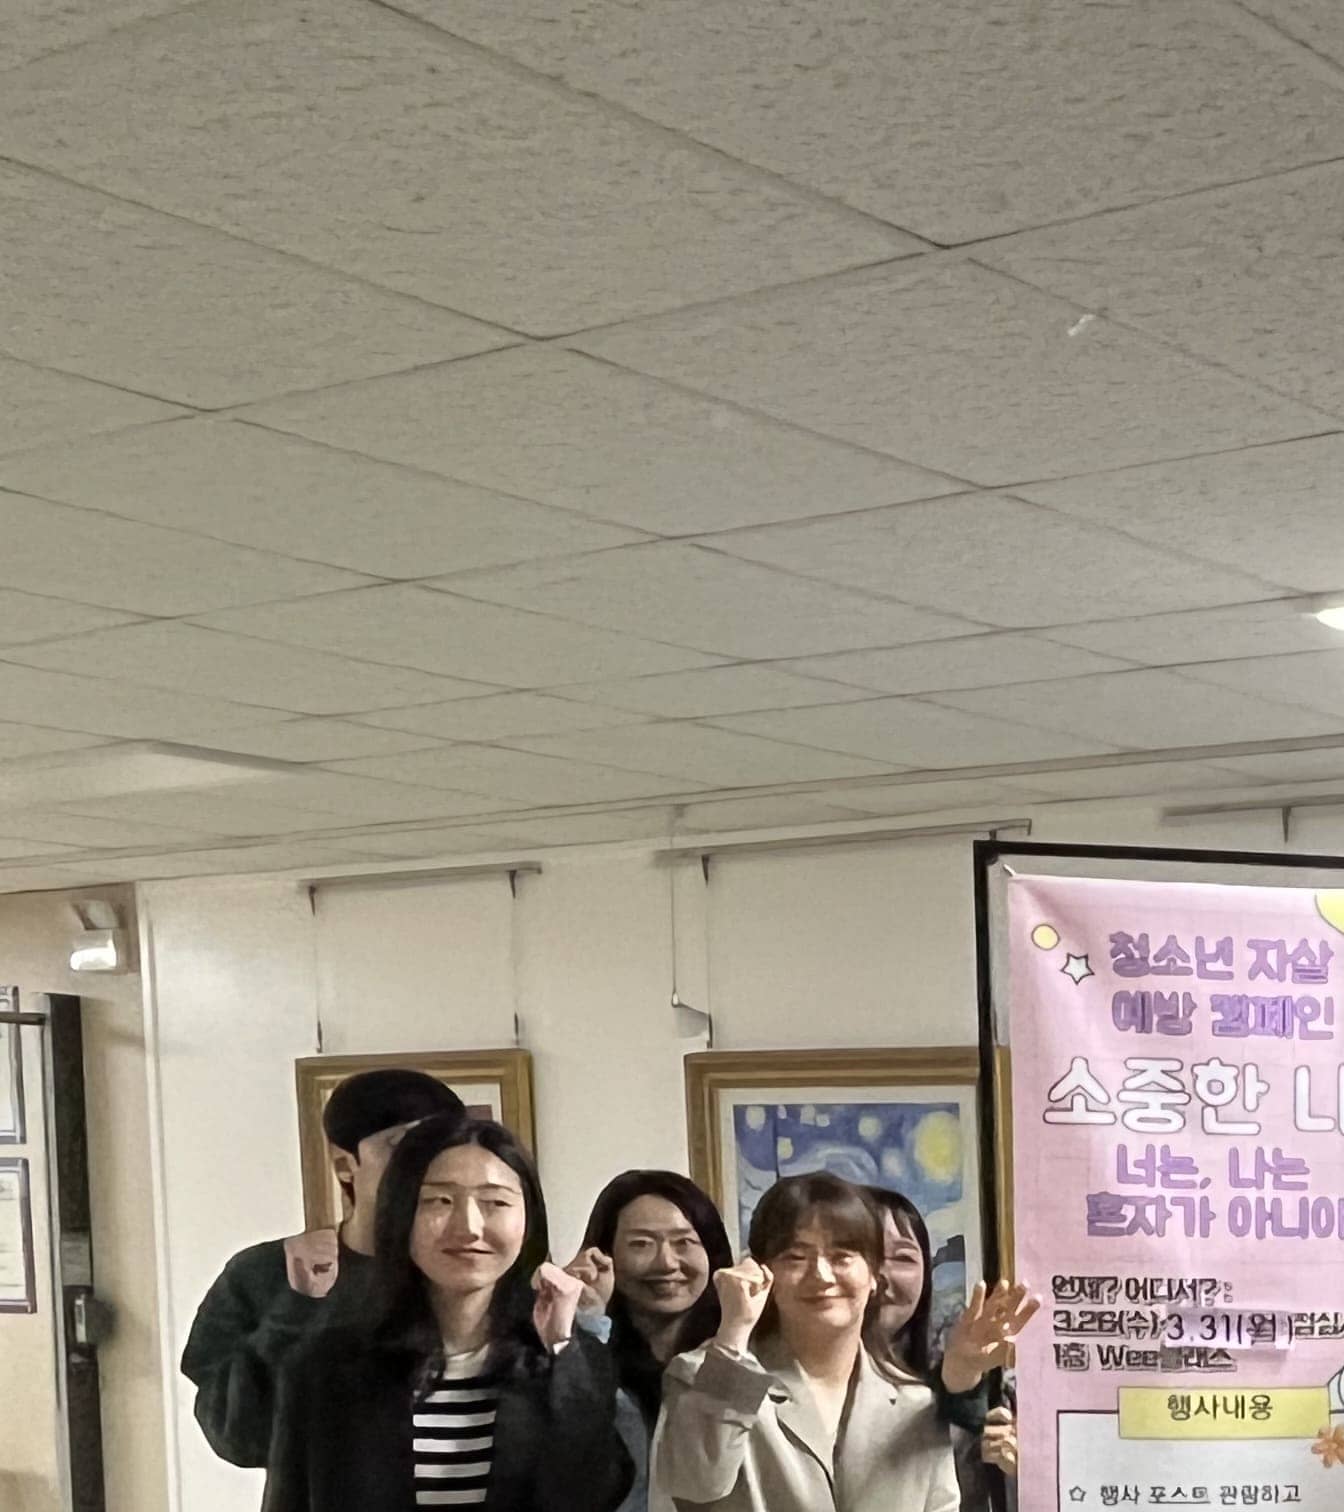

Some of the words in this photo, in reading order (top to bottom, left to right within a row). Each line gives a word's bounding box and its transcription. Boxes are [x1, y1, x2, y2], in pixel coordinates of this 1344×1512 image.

[1109, 931, 1235, 980] 청소년
[1247, 938, 1335, 984] 자살
[1112, 990, 1198, 1036] 예방
[1210, 994, 1335, 1040] 캠페인
[1042, 1056, 1270, 1135] 소중한
[1117, 1144, 1212, 1189] 너는,
[1229, 1147, 1310, 1190] 나는
[1086, 1191, 1217, 1238] 혼자가
[1167, 1394, 1274, 1421] 행사내용
[1100, 1484, 1140, 1506] 행사
[1219, 1484, 1302, 1506] 관람하고
